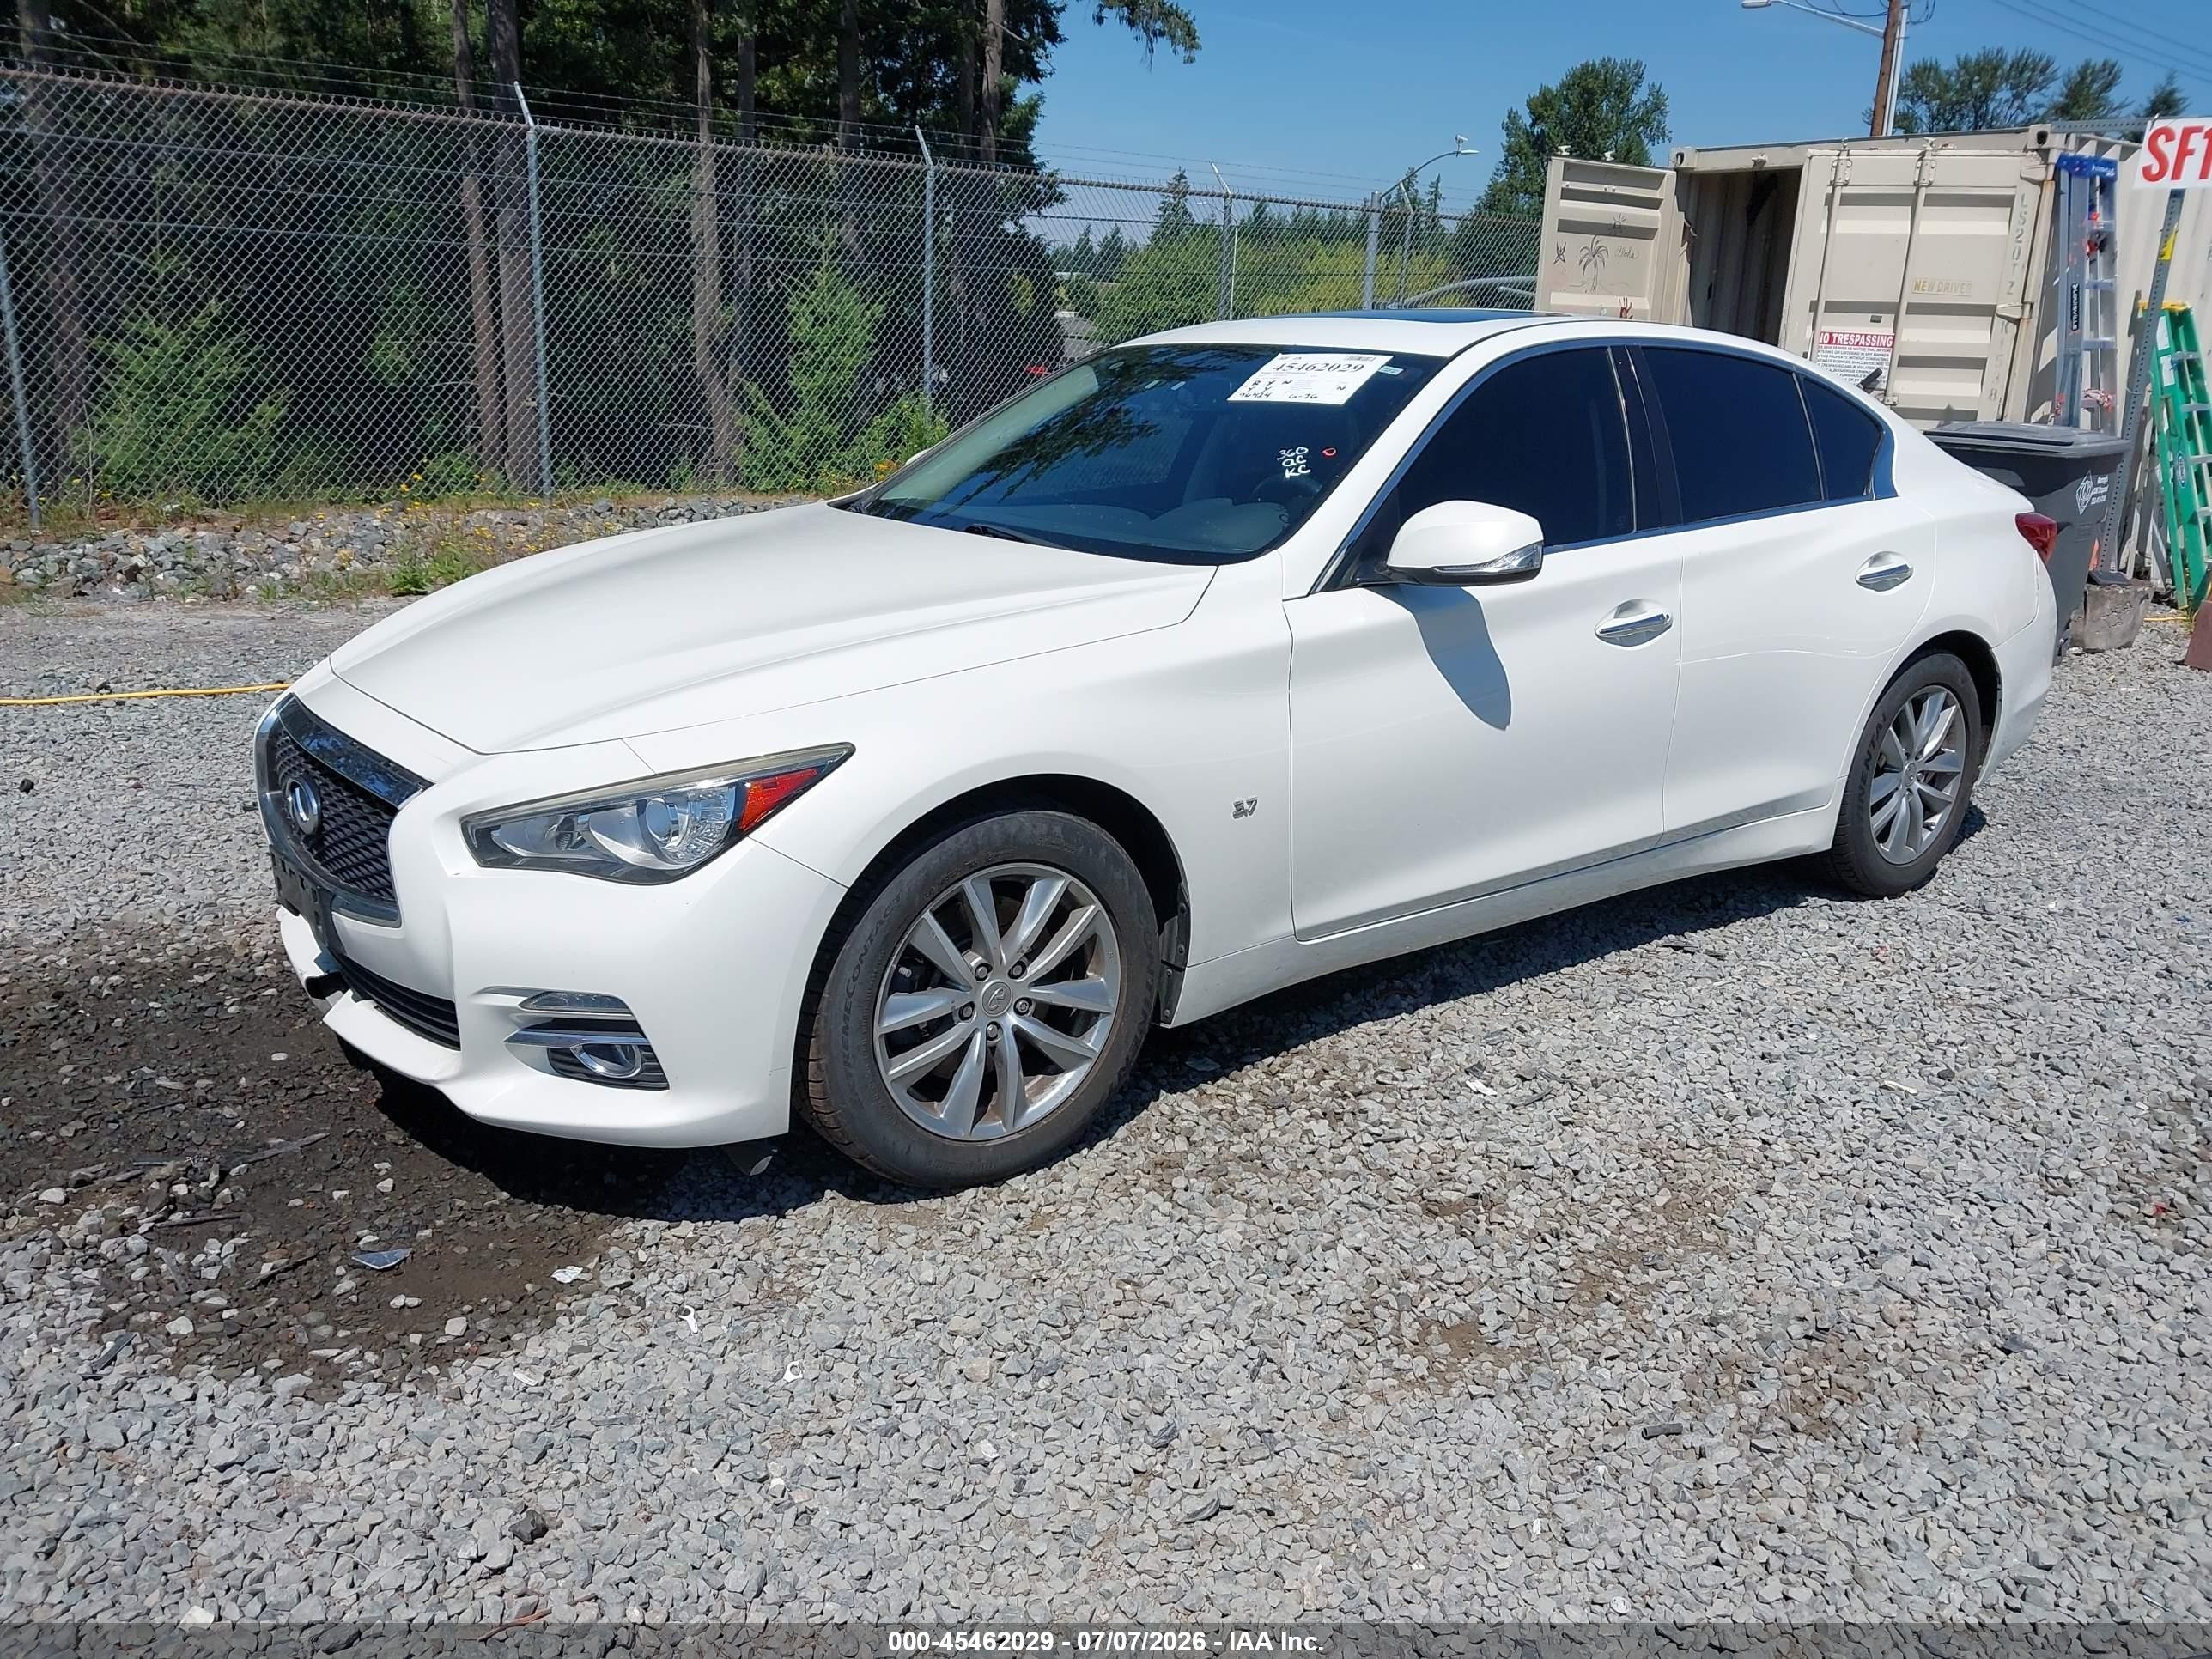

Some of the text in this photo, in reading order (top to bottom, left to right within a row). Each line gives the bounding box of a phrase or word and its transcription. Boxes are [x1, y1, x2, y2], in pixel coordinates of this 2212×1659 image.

[1913, 279, 1972, 294] NEW DRIVER
[1831, 332, 1893, 347] TRESPASSING
[1273, 362, 1364, 372] 45462029
[1276, 446, 1310, 461] 360
[1285, 464, 1312, 479] KC
